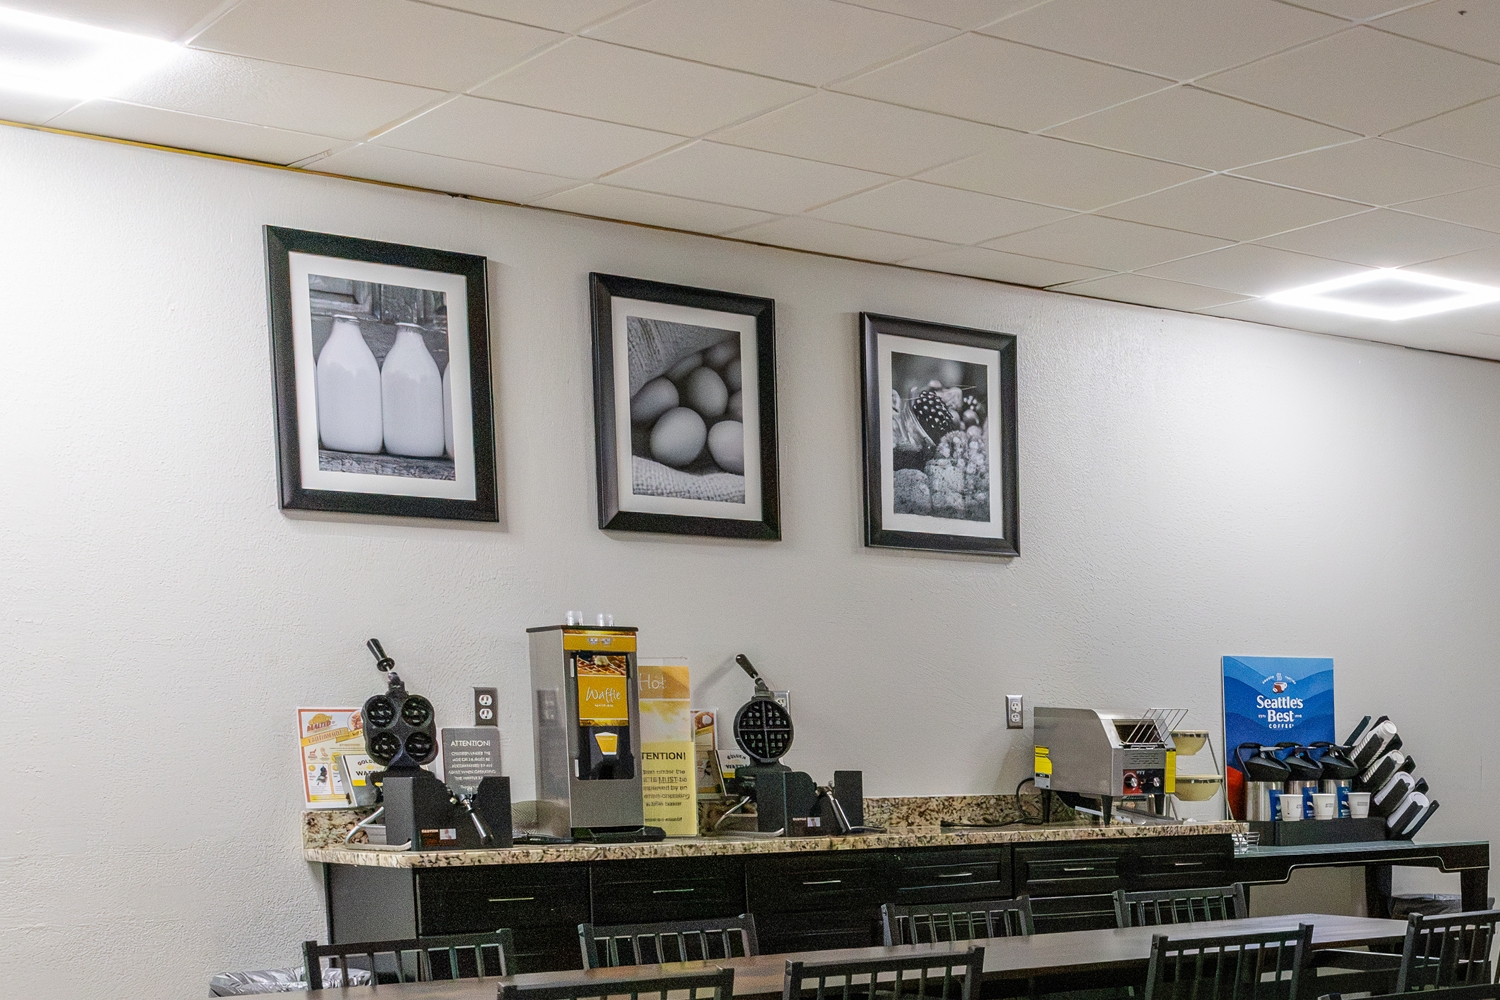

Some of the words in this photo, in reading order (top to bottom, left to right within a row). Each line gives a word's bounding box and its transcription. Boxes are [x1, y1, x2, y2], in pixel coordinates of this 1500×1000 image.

[585, 687, 621, 703] Waffle
[1256, 695, 1303, 709] Seattle's
[1267, 710, 1294, 722] Best
[641, 752, 686, 760] TENTION!
